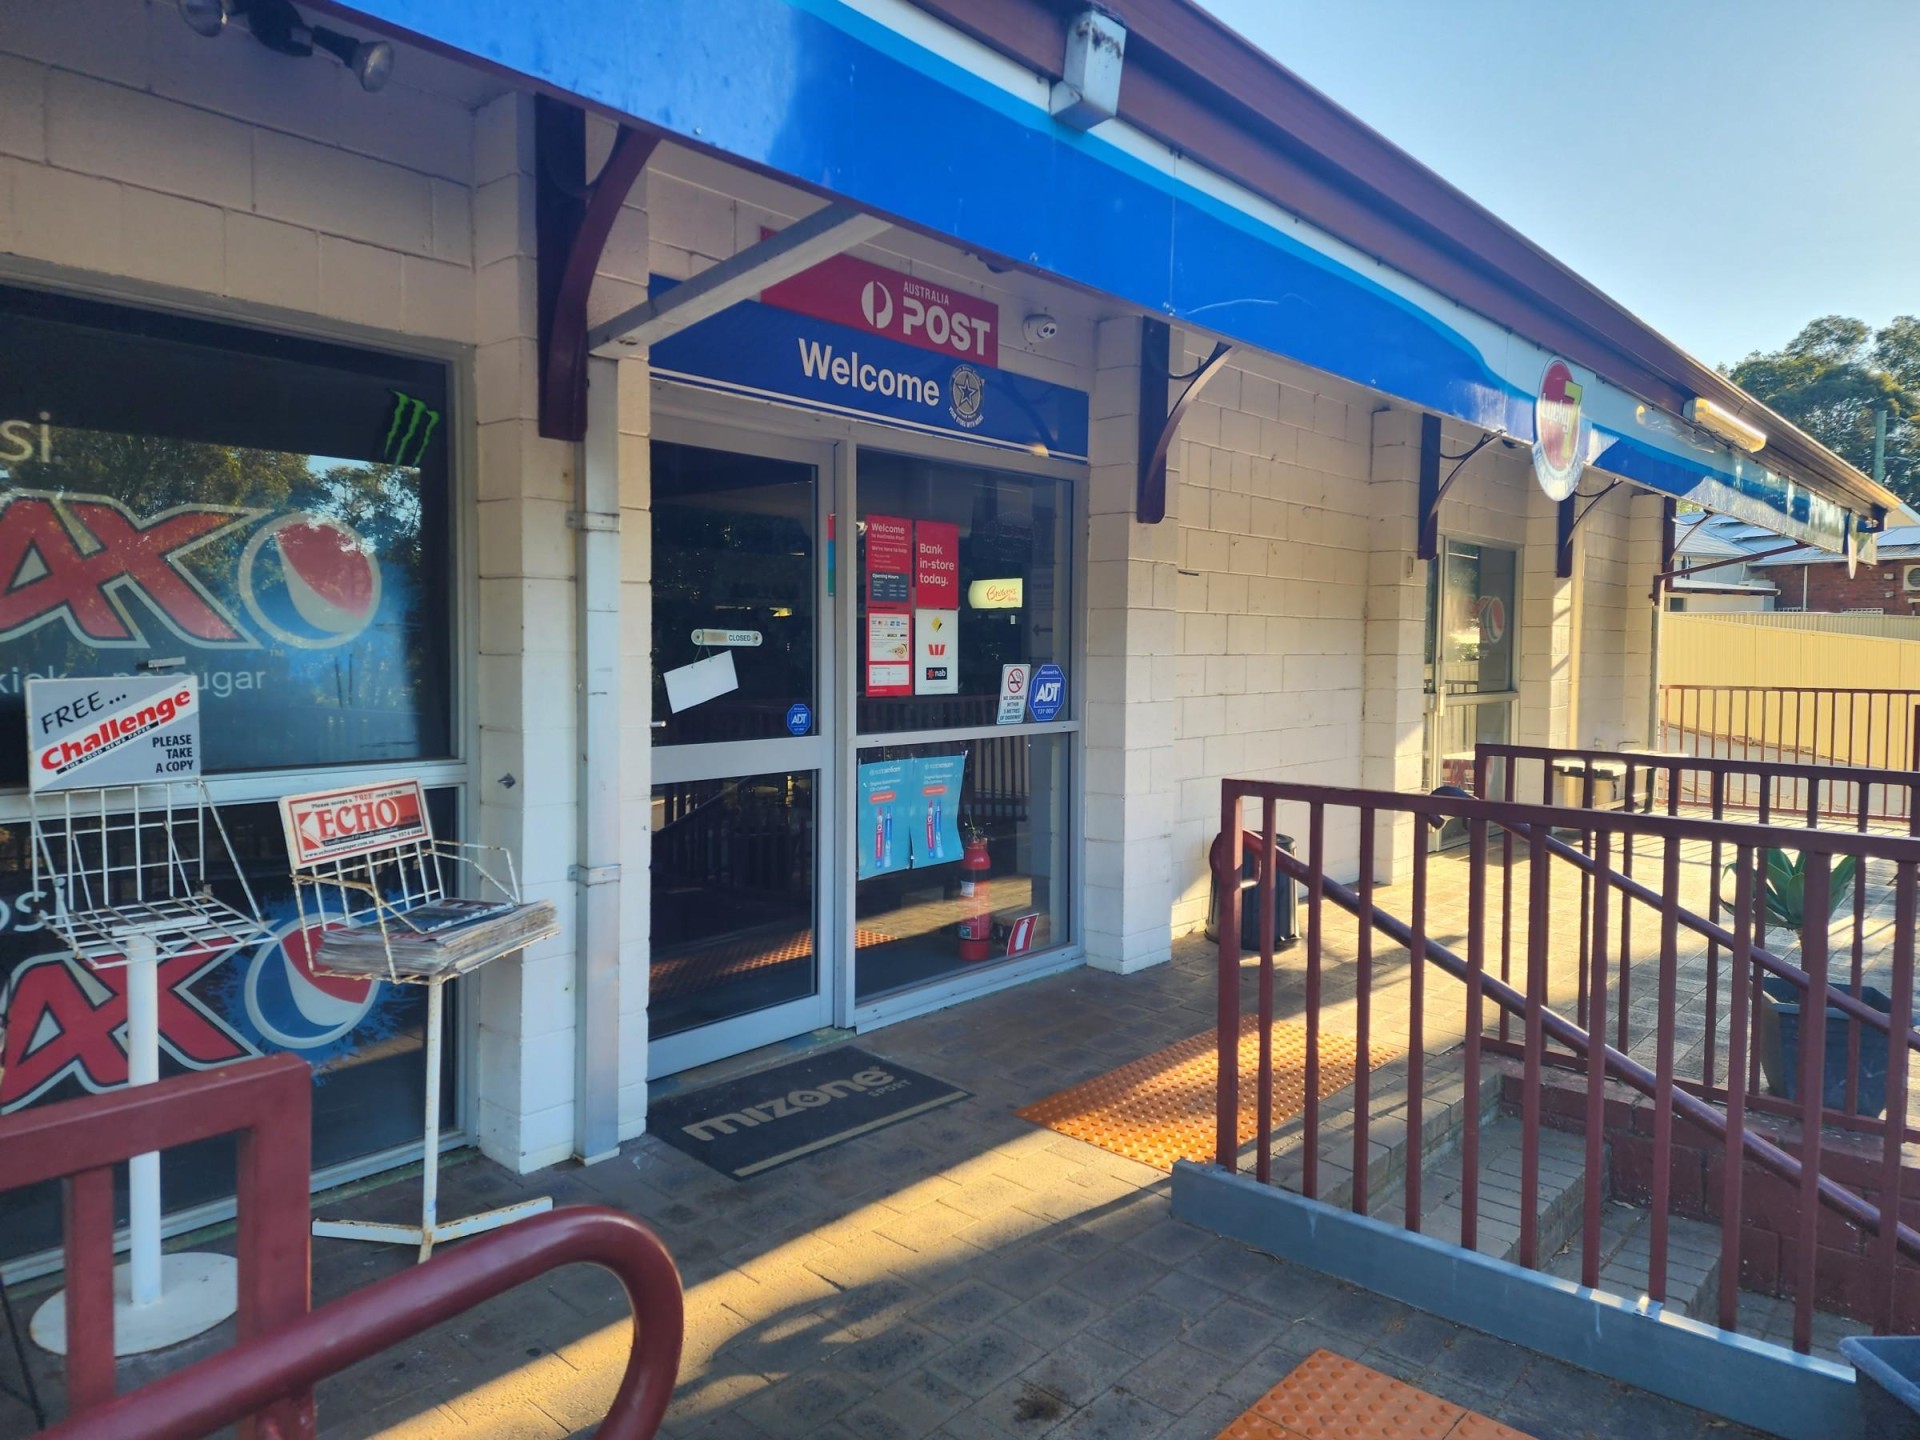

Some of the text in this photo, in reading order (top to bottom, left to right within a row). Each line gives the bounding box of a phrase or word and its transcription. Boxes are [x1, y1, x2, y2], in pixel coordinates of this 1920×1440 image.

[903, 281, 949, 305] AUSTRALIA
[903, 296, 991, 356] POST
[798, 338, 940, 406] Welcome
[871, 523, 905, 534] Welcome
[920, 543, 943, 555] Bank
[920, 558, 955, 570] in-store
[920, 573, 949, 587] today.
[728, 634, 752, 642] CLOSED
[1035, 682, 1061, 703] ADT
[791, 713, 808, 724] ADT
[41, 690, 191, 771] Challenge
[152, 734, 192, 748] PLEASE
[167, 747, 193, 760] TAKE
[155, 760, 194, 774] A COPY
[315, 798, 399, 839] ECHO
[868, 1080, 913, 1098] SPORT
[681, 1067, 895, 1141] mizone
